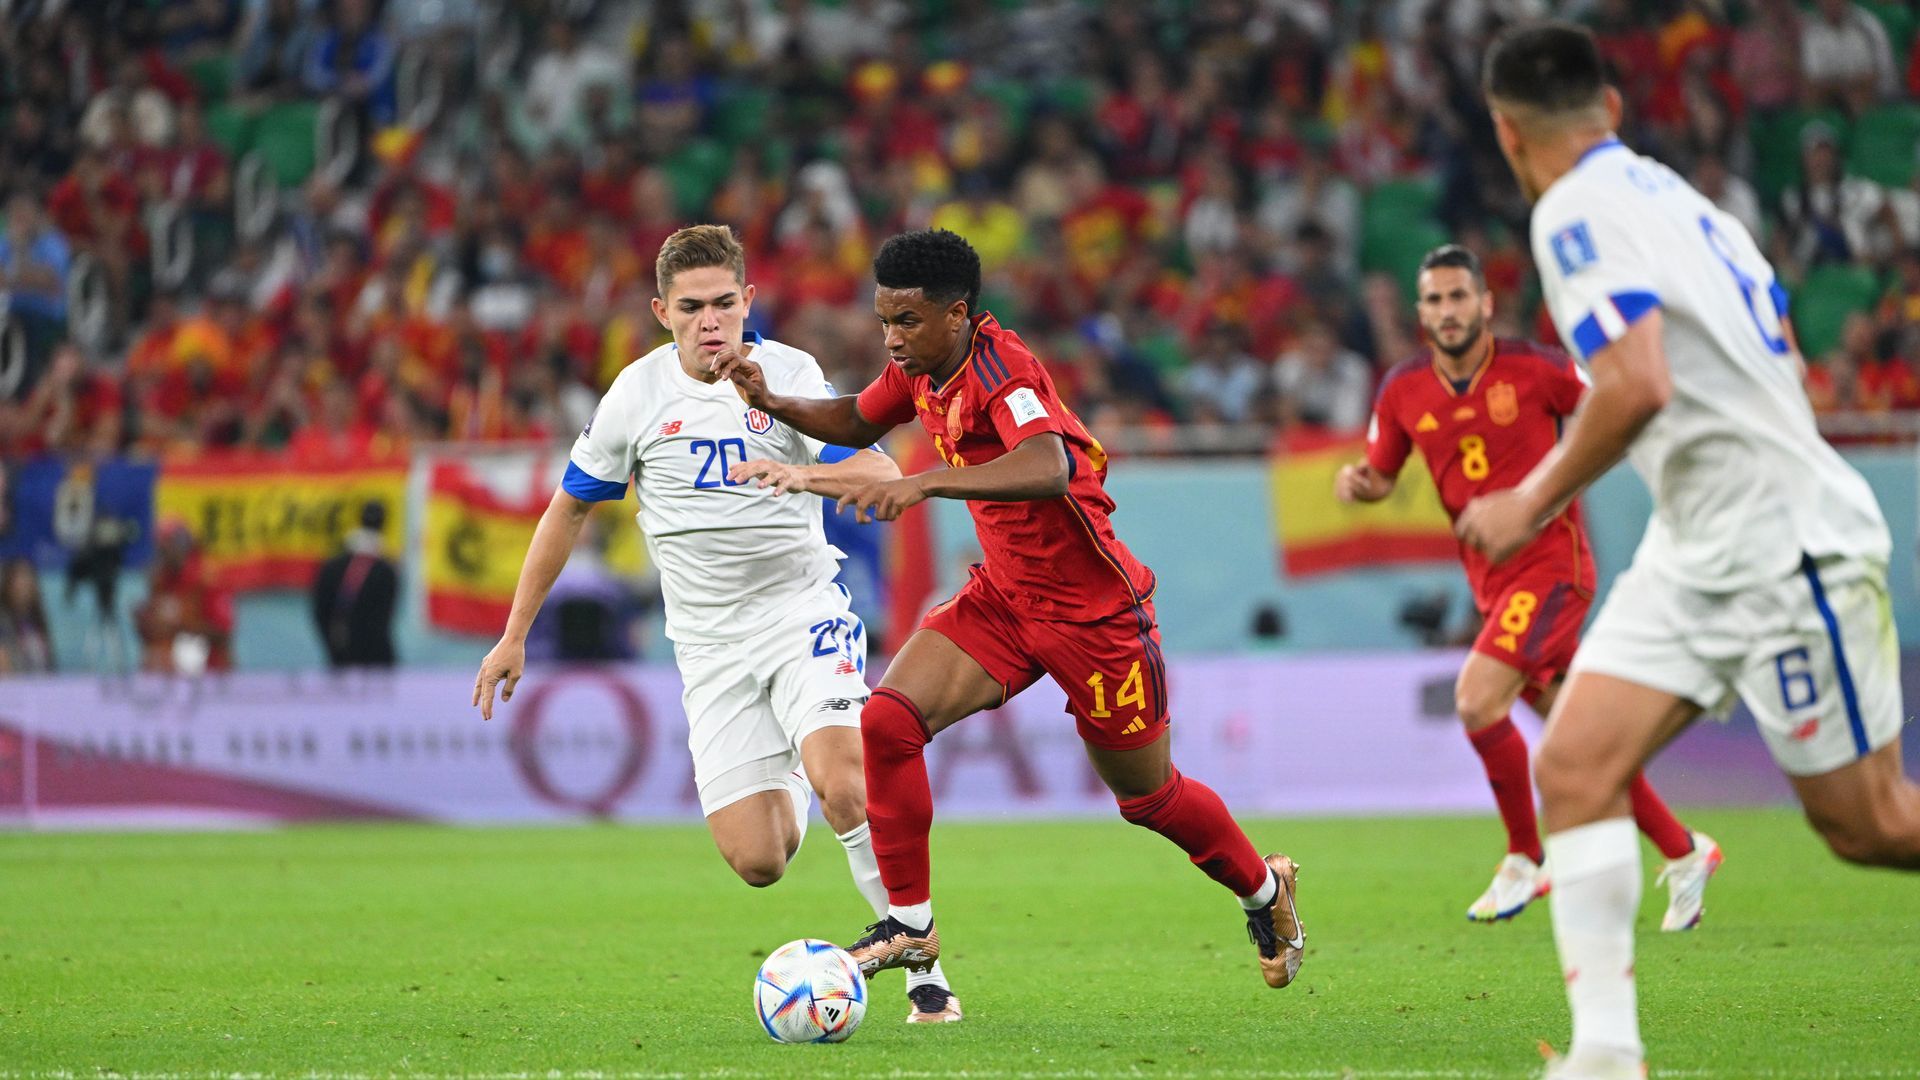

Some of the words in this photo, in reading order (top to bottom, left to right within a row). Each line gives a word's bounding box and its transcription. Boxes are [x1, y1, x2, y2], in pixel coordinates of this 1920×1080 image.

[690, 438, 749, 489] 20
[1459, 434, 1490, 481] 8
[1499, 590, 1538, 635] 8
[1086, 660, 1147, 719] 14
[1776, 646, 1818, 712] 6
